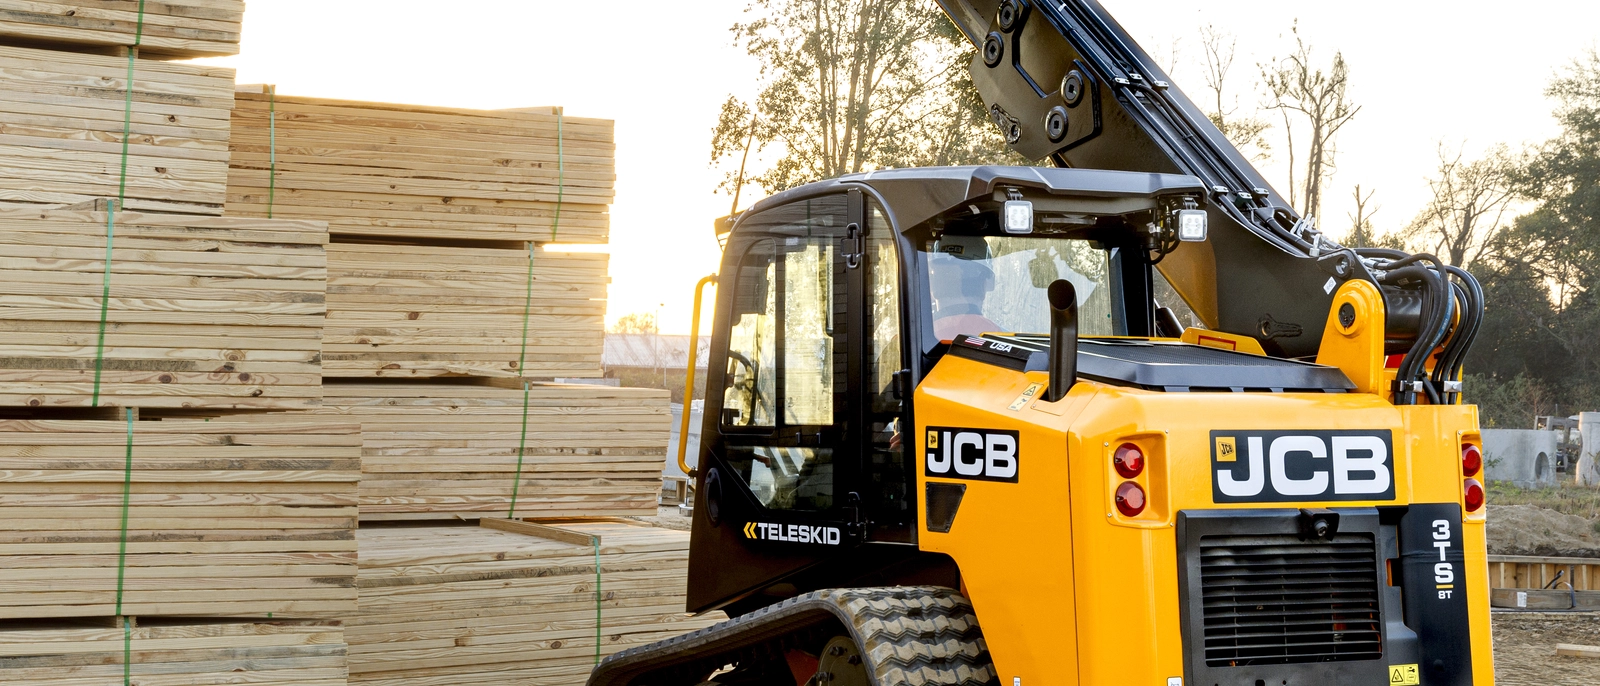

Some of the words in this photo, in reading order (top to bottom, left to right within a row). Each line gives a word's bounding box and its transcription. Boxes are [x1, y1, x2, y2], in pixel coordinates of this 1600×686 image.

[989, 342, 1012, 352] USA
[927, 431, 1017, 478] JCB
[1217, 435, 1391, 497] JCB
[757, 522, 841, 545] TELESKID
[1438, 590, 1453, 600] 8T
